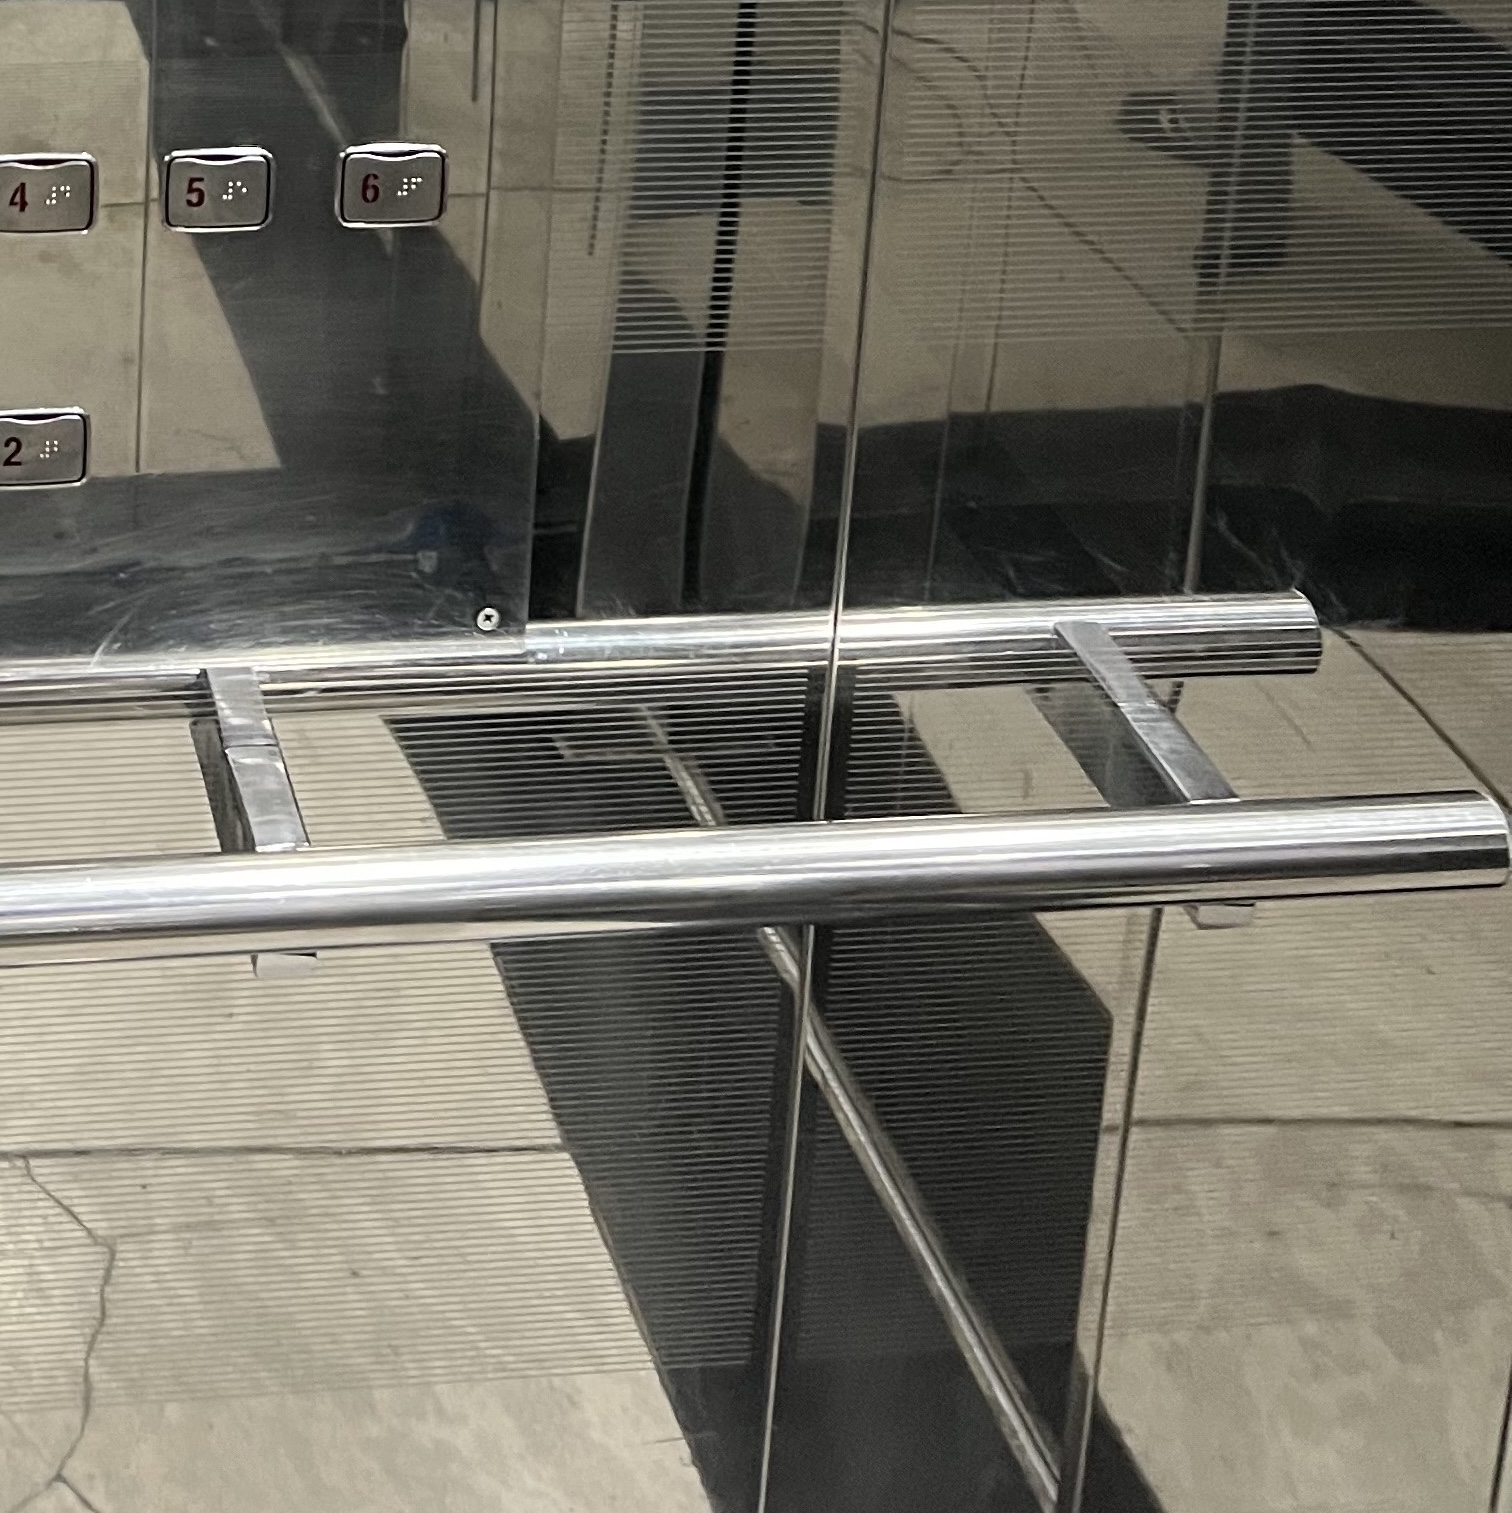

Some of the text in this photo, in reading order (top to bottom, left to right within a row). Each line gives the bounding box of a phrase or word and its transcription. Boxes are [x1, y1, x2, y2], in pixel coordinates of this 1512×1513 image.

[8, 182, 29, 213] 4
[186, 177, 206, 207] 5
[361, 174, 380, 204] 6
[2, 437, 23, 467] 2
